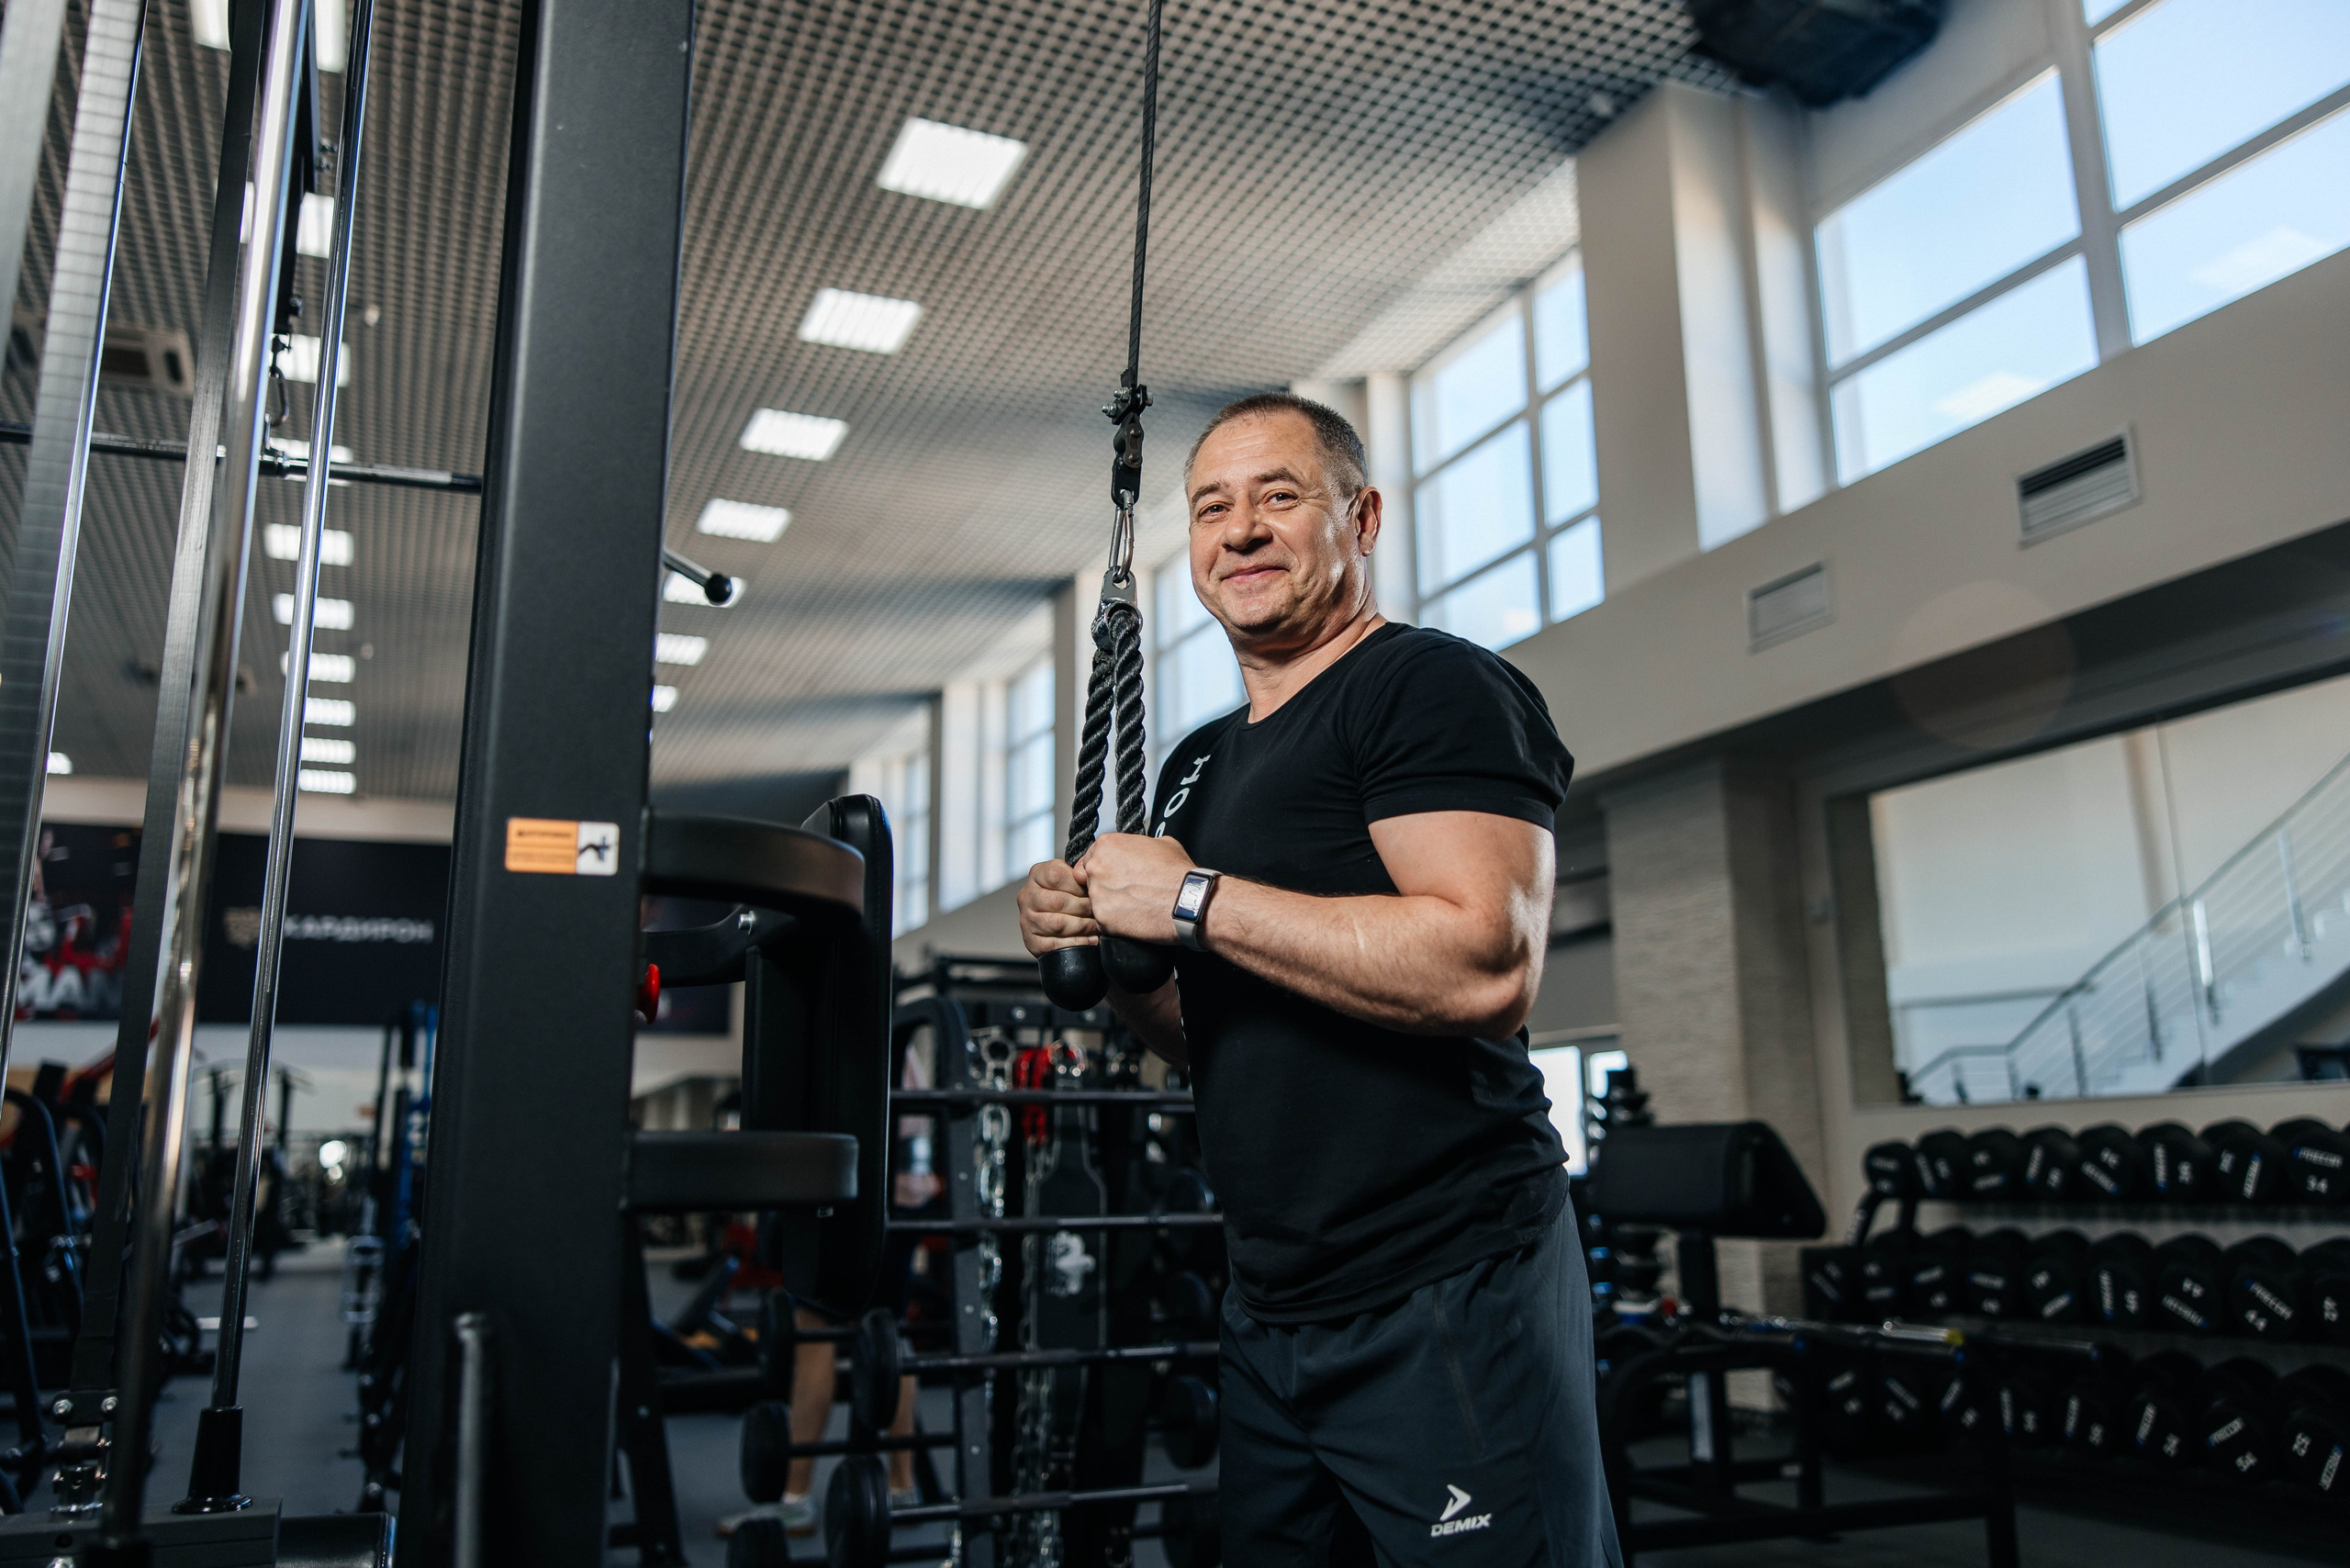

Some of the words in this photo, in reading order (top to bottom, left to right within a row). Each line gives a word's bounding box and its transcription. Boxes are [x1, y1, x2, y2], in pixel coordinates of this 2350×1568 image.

[2307, 1175, 2329, 1193] 34
[2291, 1431, 2311, 1458] 52
[1430, 1513, 1493, 1538] DEMIX
